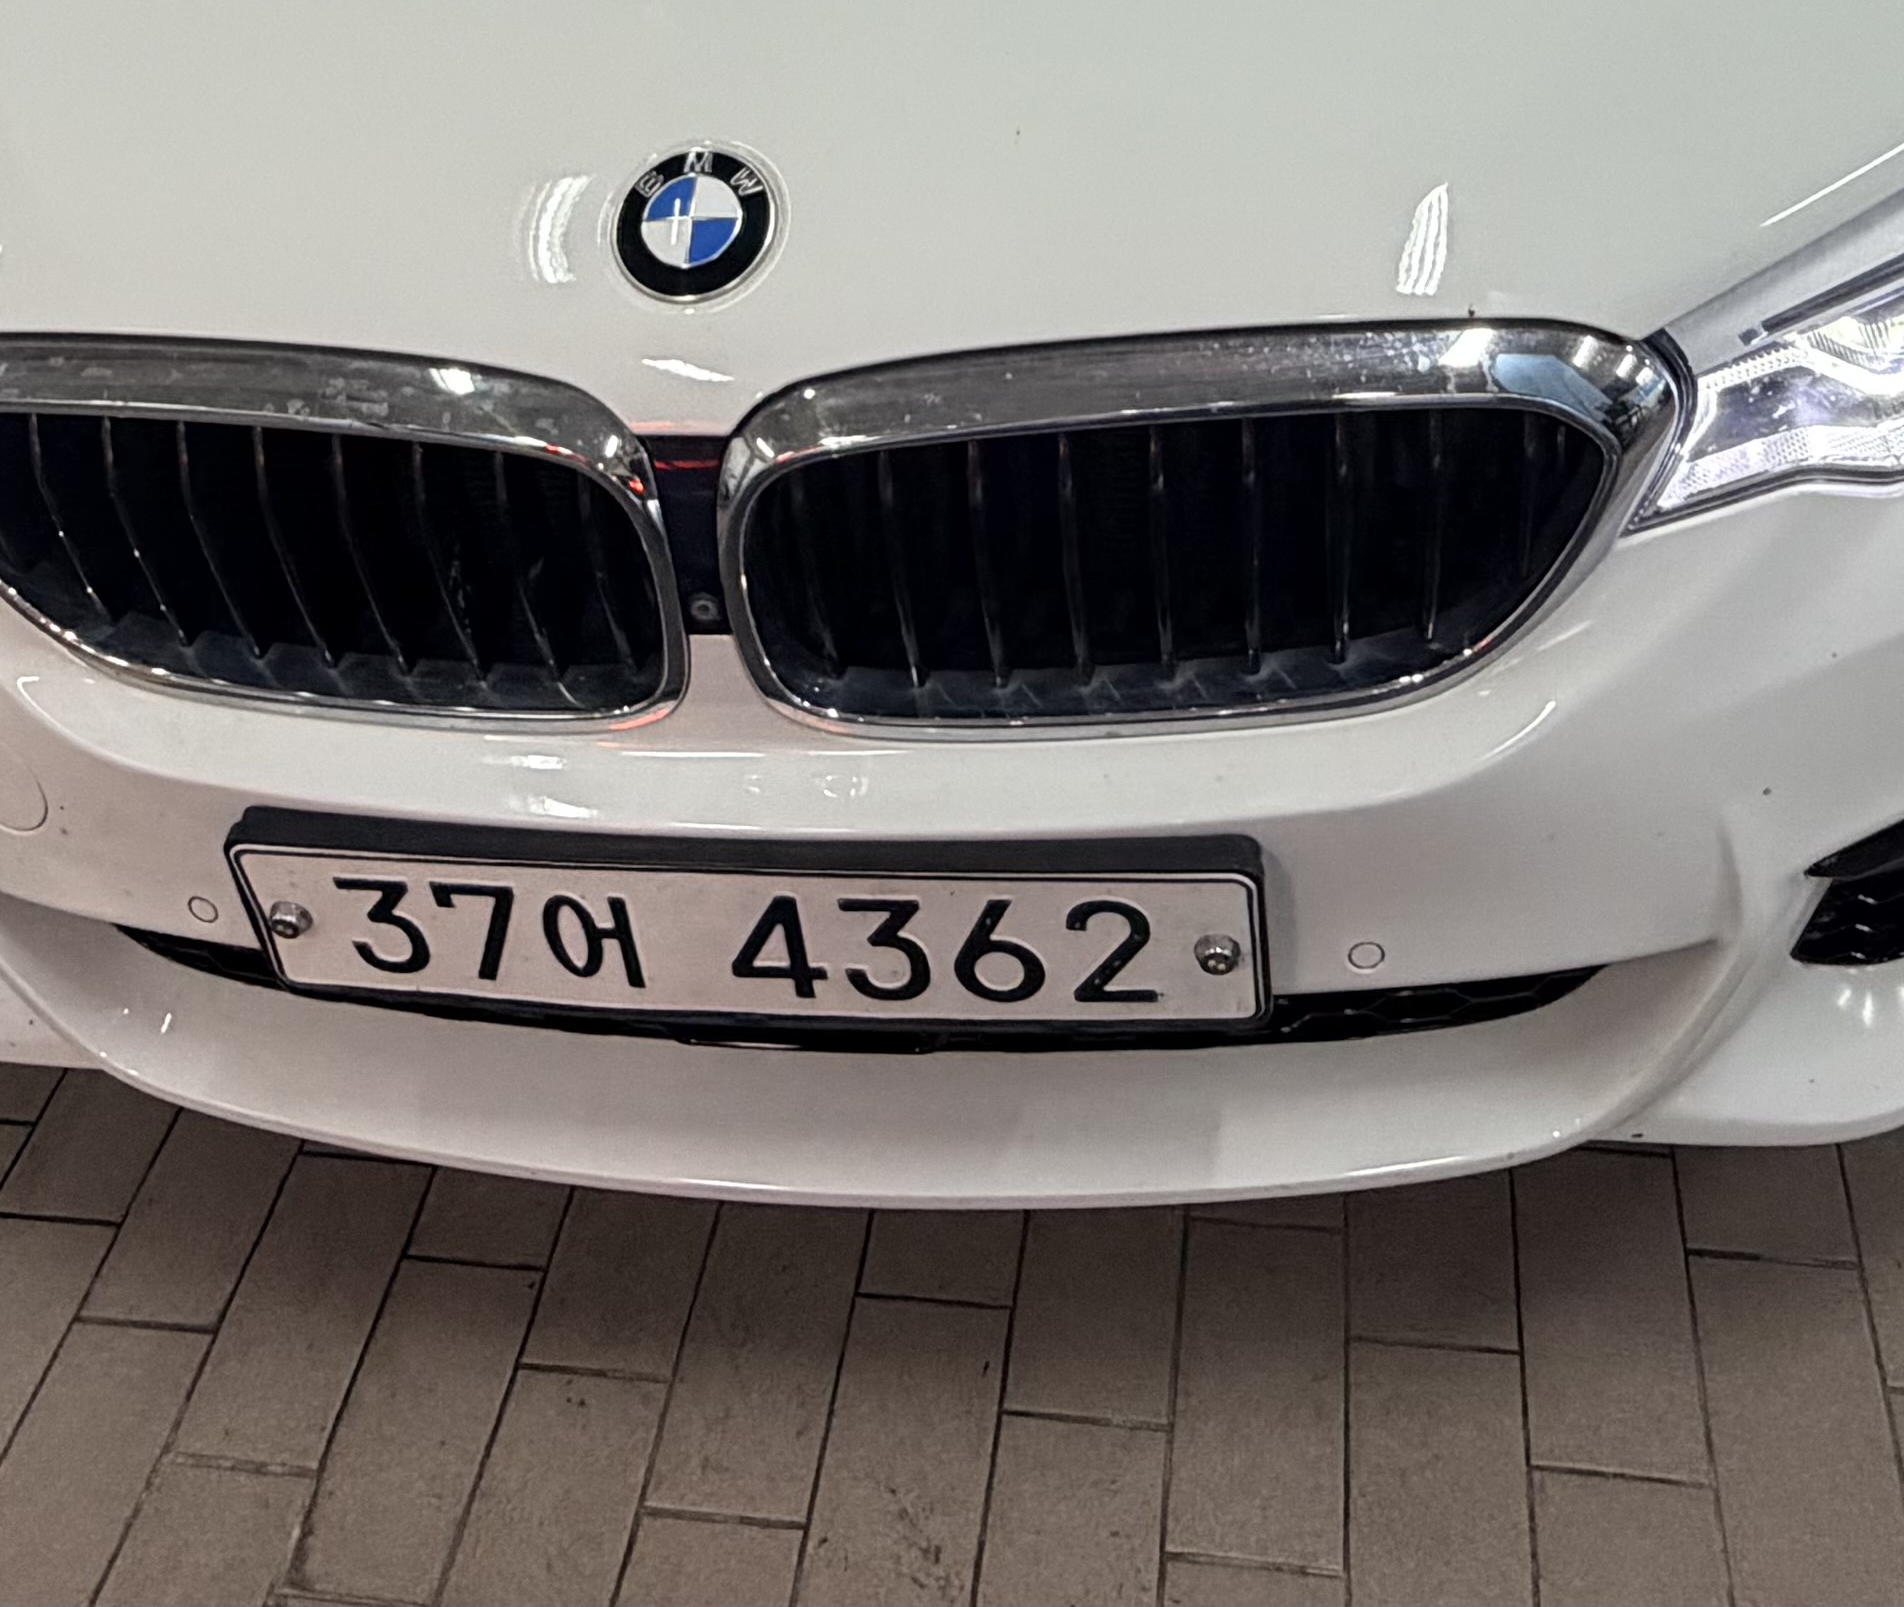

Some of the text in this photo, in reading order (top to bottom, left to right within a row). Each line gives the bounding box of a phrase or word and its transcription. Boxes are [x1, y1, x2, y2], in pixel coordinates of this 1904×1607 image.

[634, 150, 764, 198] BMW
[332, 875, 1161, 1003] 37어 4362
